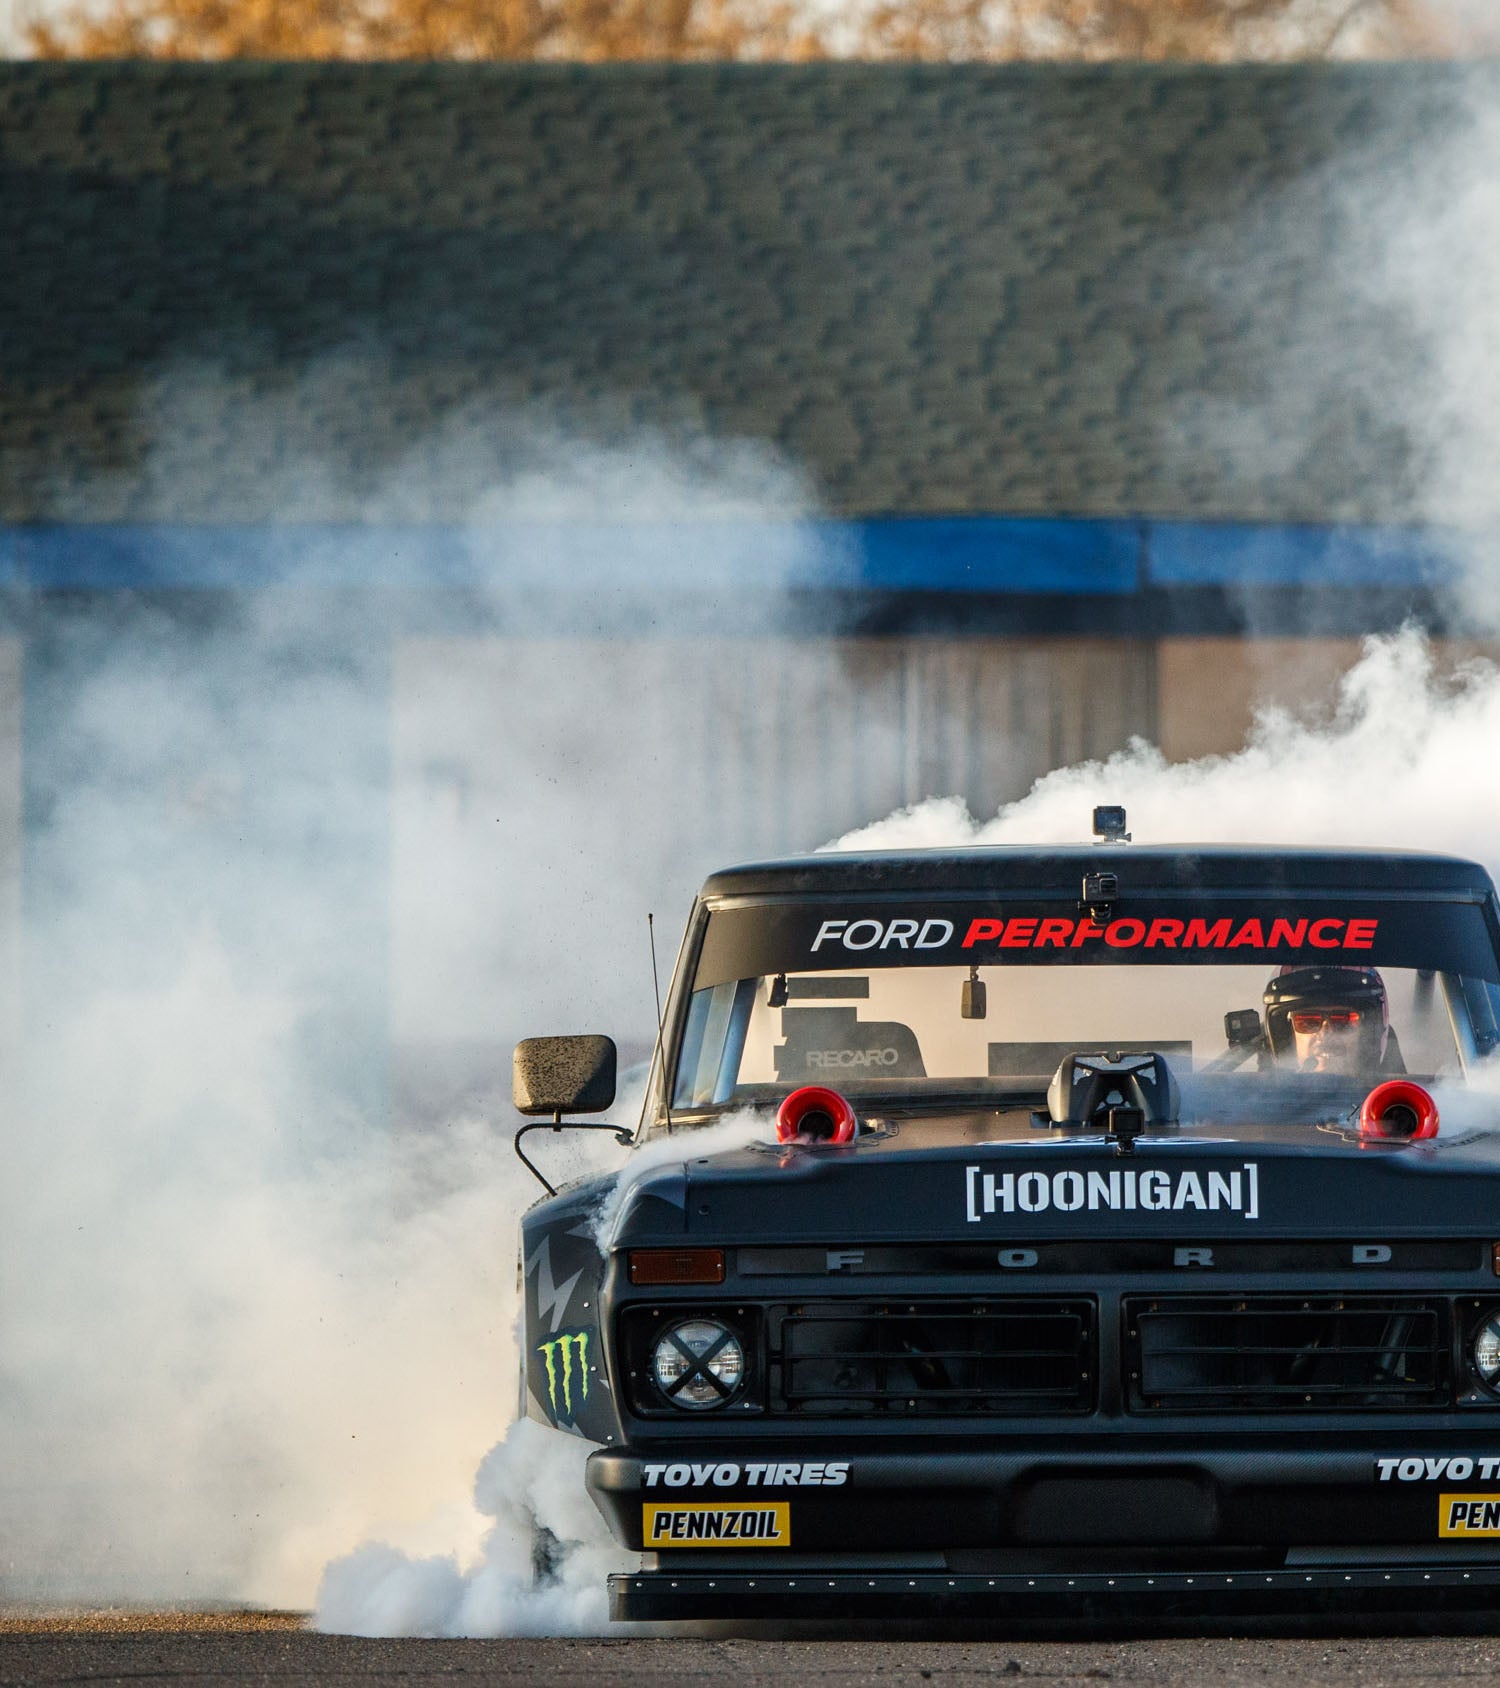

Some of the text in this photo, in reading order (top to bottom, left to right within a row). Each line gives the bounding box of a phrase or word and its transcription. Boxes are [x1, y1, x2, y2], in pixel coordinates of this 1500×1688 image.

[810, 917, 1379, 952] FORD PERFORMANCE
[806, 1047, 899, 1068] RECARO
[966, 1163, 1259, 1222] [HOONIGAN]
[644, 1462, 850, 1486] TOYO TIRES
[1377, 1457, 1474, 1481] TOYO
[652, 1510, 781, 1540] PENNZOIL
